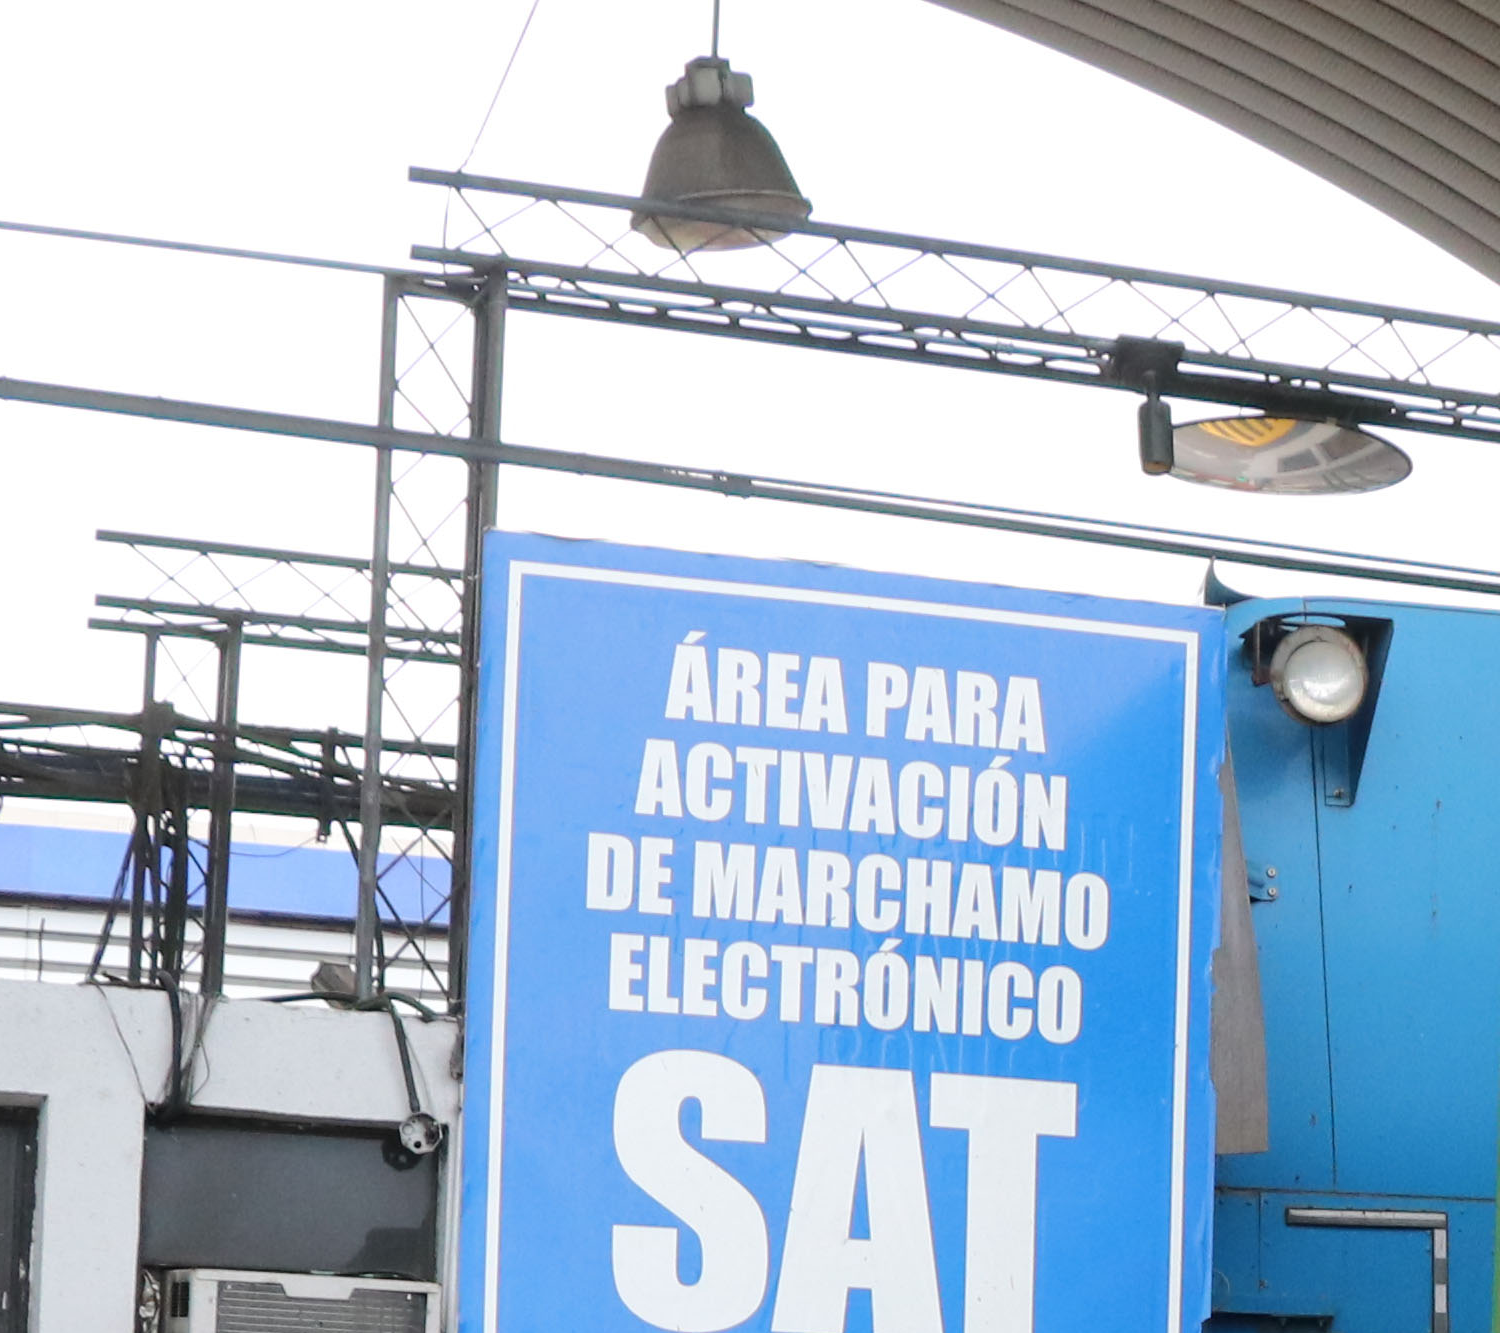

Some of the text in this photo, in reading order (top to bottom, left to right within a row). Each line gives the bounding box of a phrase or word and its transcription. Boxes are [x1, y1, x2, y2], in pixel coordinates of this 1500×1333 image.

[664, 630, 1047, 754] ÁREA PARA
[634, 738, 1067, 851] ACTIVACIÓN
[586, 831, 1109, 950] DE MARCHAMO
[608, 932, 1082, 1044] ELECTRÓNICO
